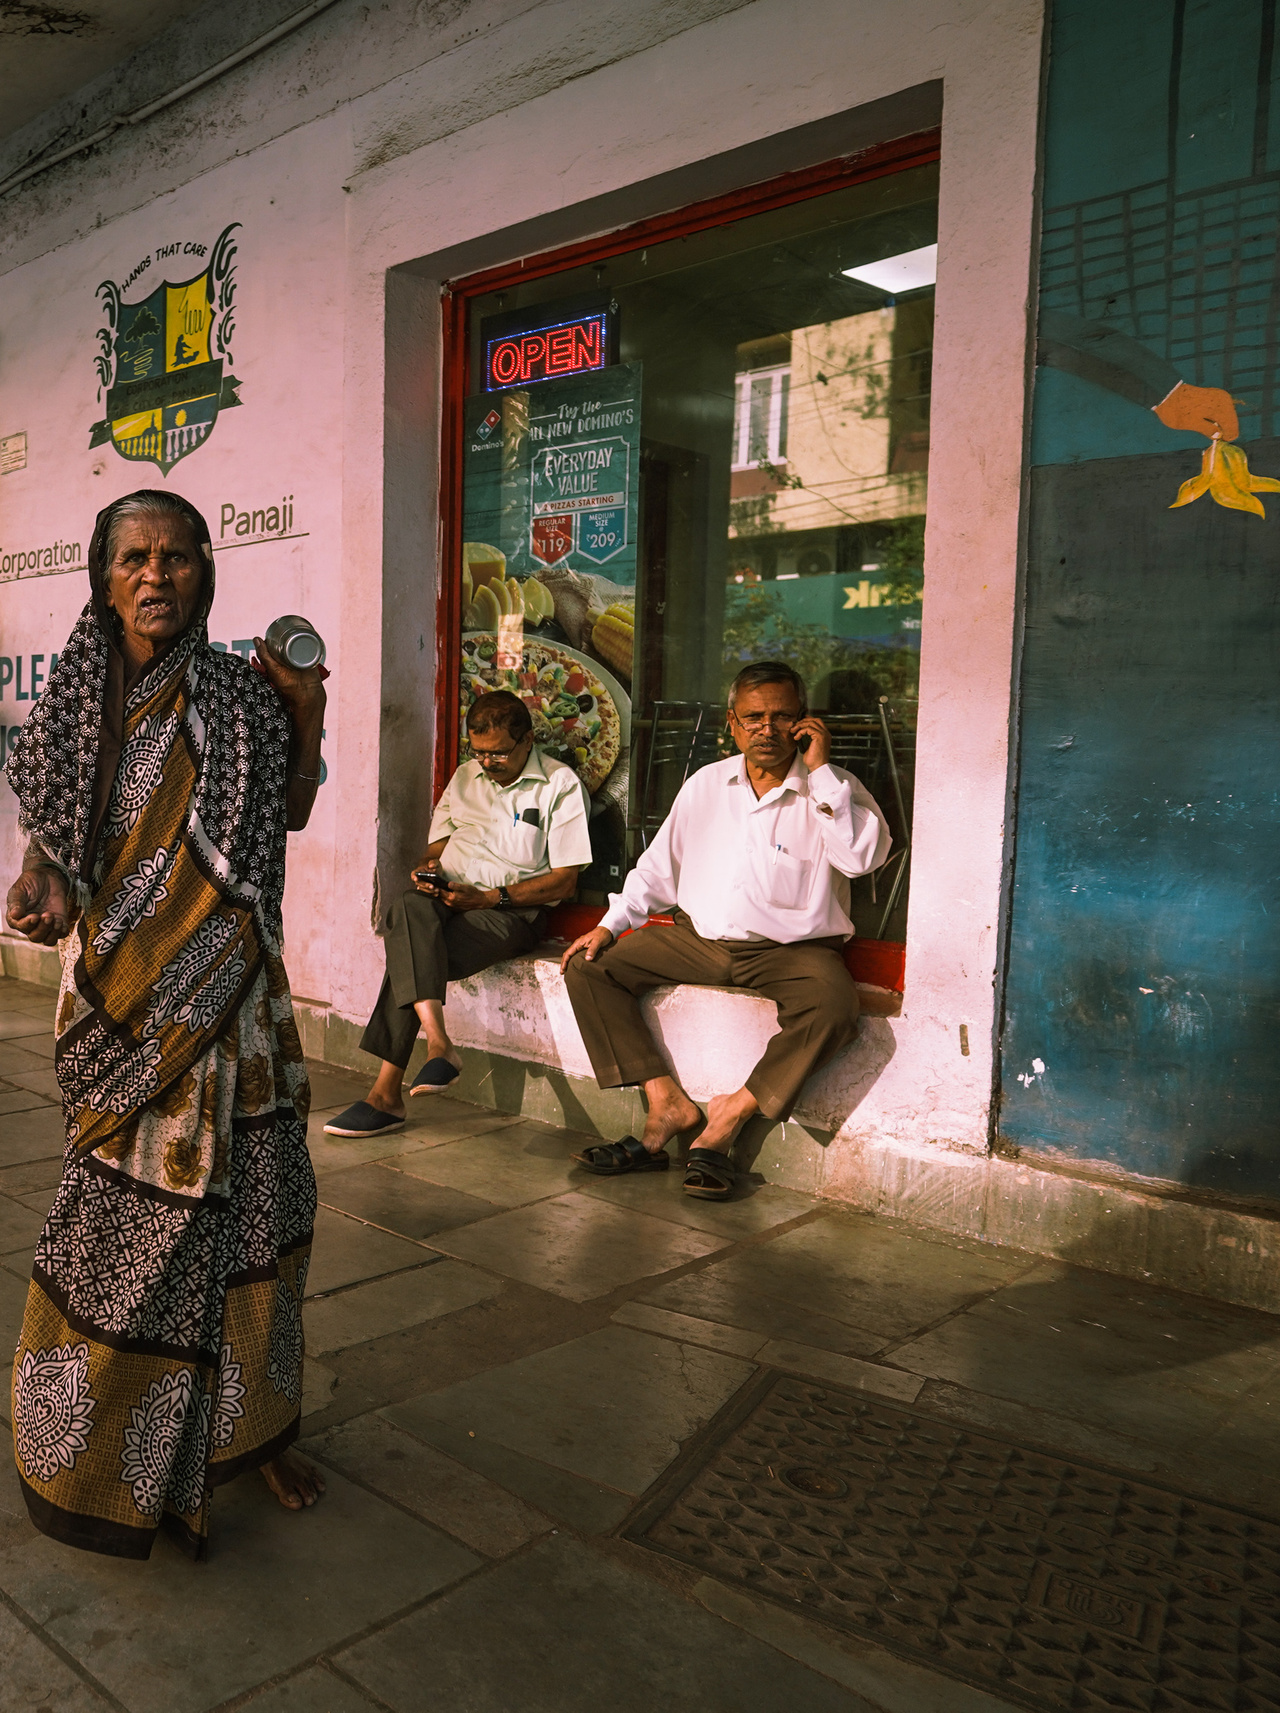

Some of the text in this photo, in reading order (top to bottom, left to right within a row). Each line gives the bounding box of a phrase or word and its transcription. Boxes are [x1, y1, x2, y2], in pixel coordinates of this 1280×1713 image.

[121, 242, 208, 293] HANDS THAT CARE
[492, 321, 600, 383] OPEN
[126, 372, 188, 396] CORPORATION
[557, 400, 602, 420] Try the
[528, 408, 634, 442] ALL NEW DOMINO'S
[471, 439, 505, 452] Domino's
[545, 447, 614, 477] EVERYDAY
[558, 472, 599, 496] VALUE
[550, 500, 576, 510] PIZZAS
[578, 495, 615, 507] STARTING
[220, 494, 294, 539] Panaji
[538, 517, 566, 527] REGULAR
[588, 511, 616, 522] MEDIUM
[595, 519, 609, 527] SIZE
